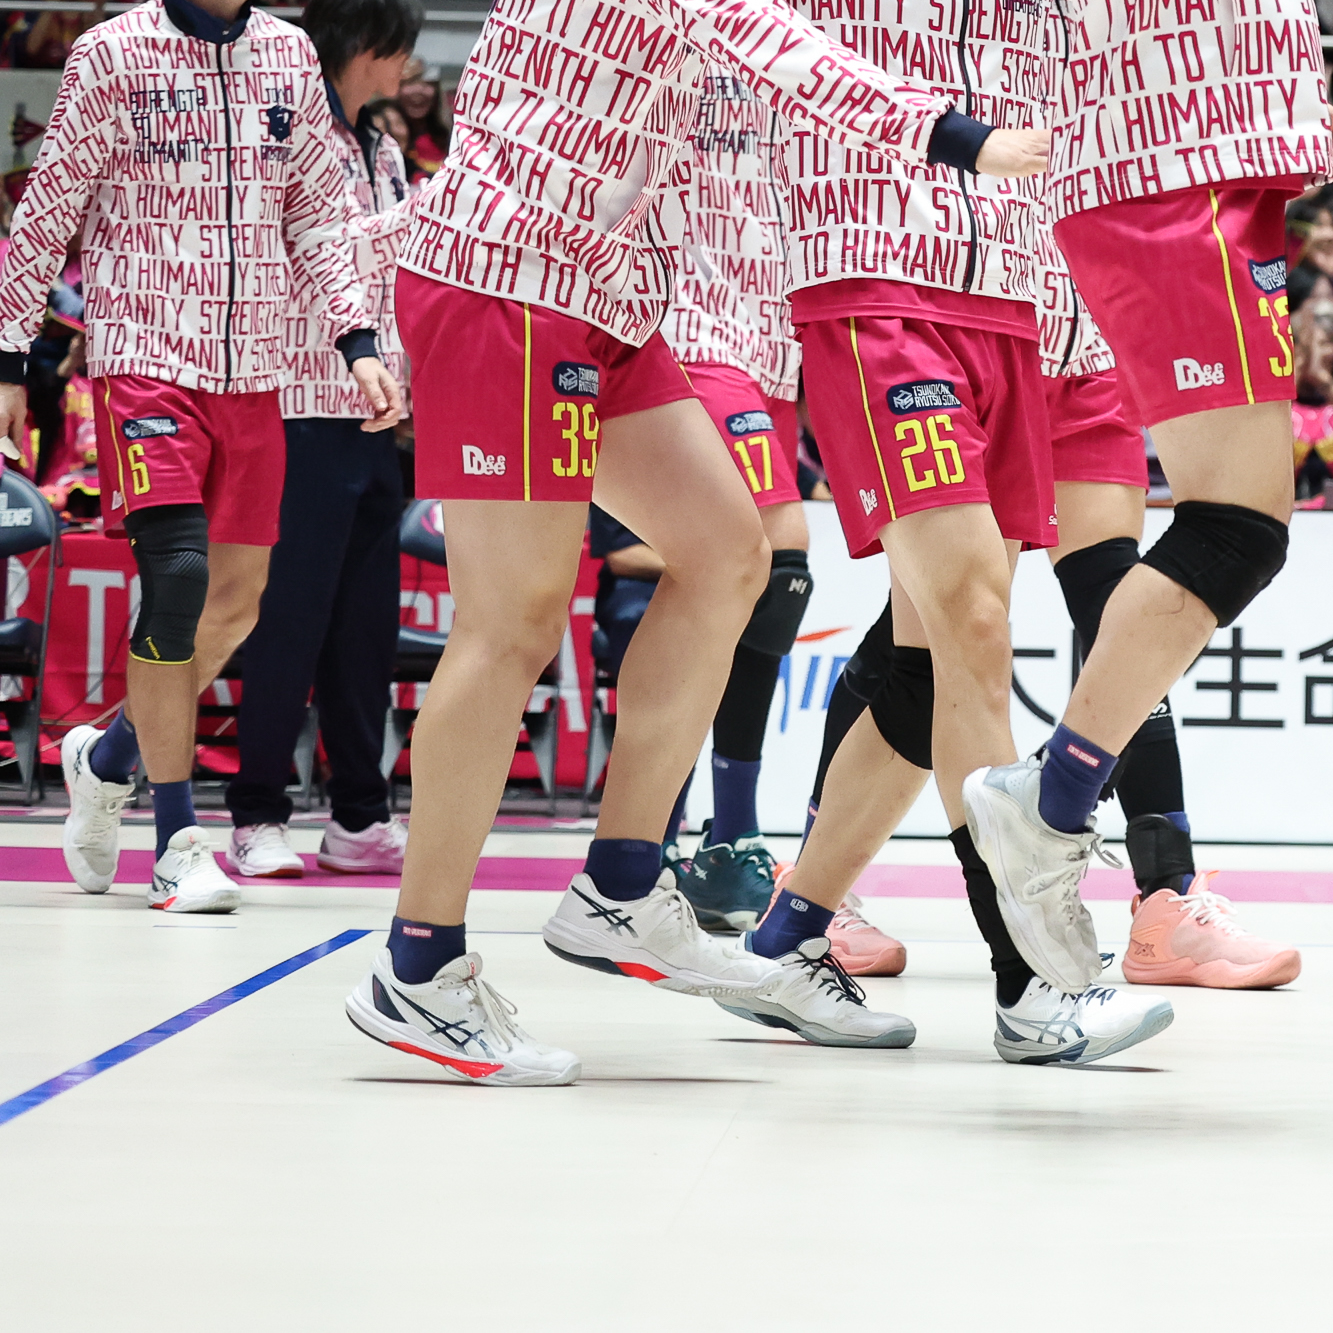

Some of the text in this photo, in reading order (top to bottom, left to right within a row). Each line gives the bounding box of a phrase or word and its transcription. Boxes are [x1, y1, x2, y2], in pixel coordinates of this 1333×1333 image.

[122, 37, 235, 70] HUMANITY
[251, 37, 319, 68] STREN
[841, 24, 984, 87] HUMANITY
[1153, 30, 1204, 86] TO
[130, 89, 206, 115] STRENGTH
[194, 72, 293, 105] STRENGTH
[605, 68, 651, 125] TO
[797, 56, 935, 159] STRENGT
[1120, 78, 1297, 154] HUMANITY
[101, 147, 288, 183] UMANITY STRENGTH
[134, 139, 211, 164] HUMANITY
[696, 129, 758, 155] HUMANIT
[793, 131, 828, 178] TO
[1175, 144, 1225, 185] TO
[455, 121, 603, 222] TRENTH TO
[137, 185, 248, 221] HUMANITY
[91, 219, 279, 259] HUMANITY STRENGTH
[399, 215, 577, 309] STRENGTH TO
[799, 228, 990, 291] TO HUMANITY
[138, 258, 249, 297] HUMANITY
[85, 286, 280, 336] HUMANITY STRENGTH
[104, 323, 245, 374] TO HUMANITY
[912, 383, 951, 396] TSUNOKA
[914, 395, 942, 408] RYUTSU
[551, 402, 599, 478] 39
[734, 435, 773, 493] 17
[894, 414, 966, 493] 26
[127, 443, 151, 496] 6
